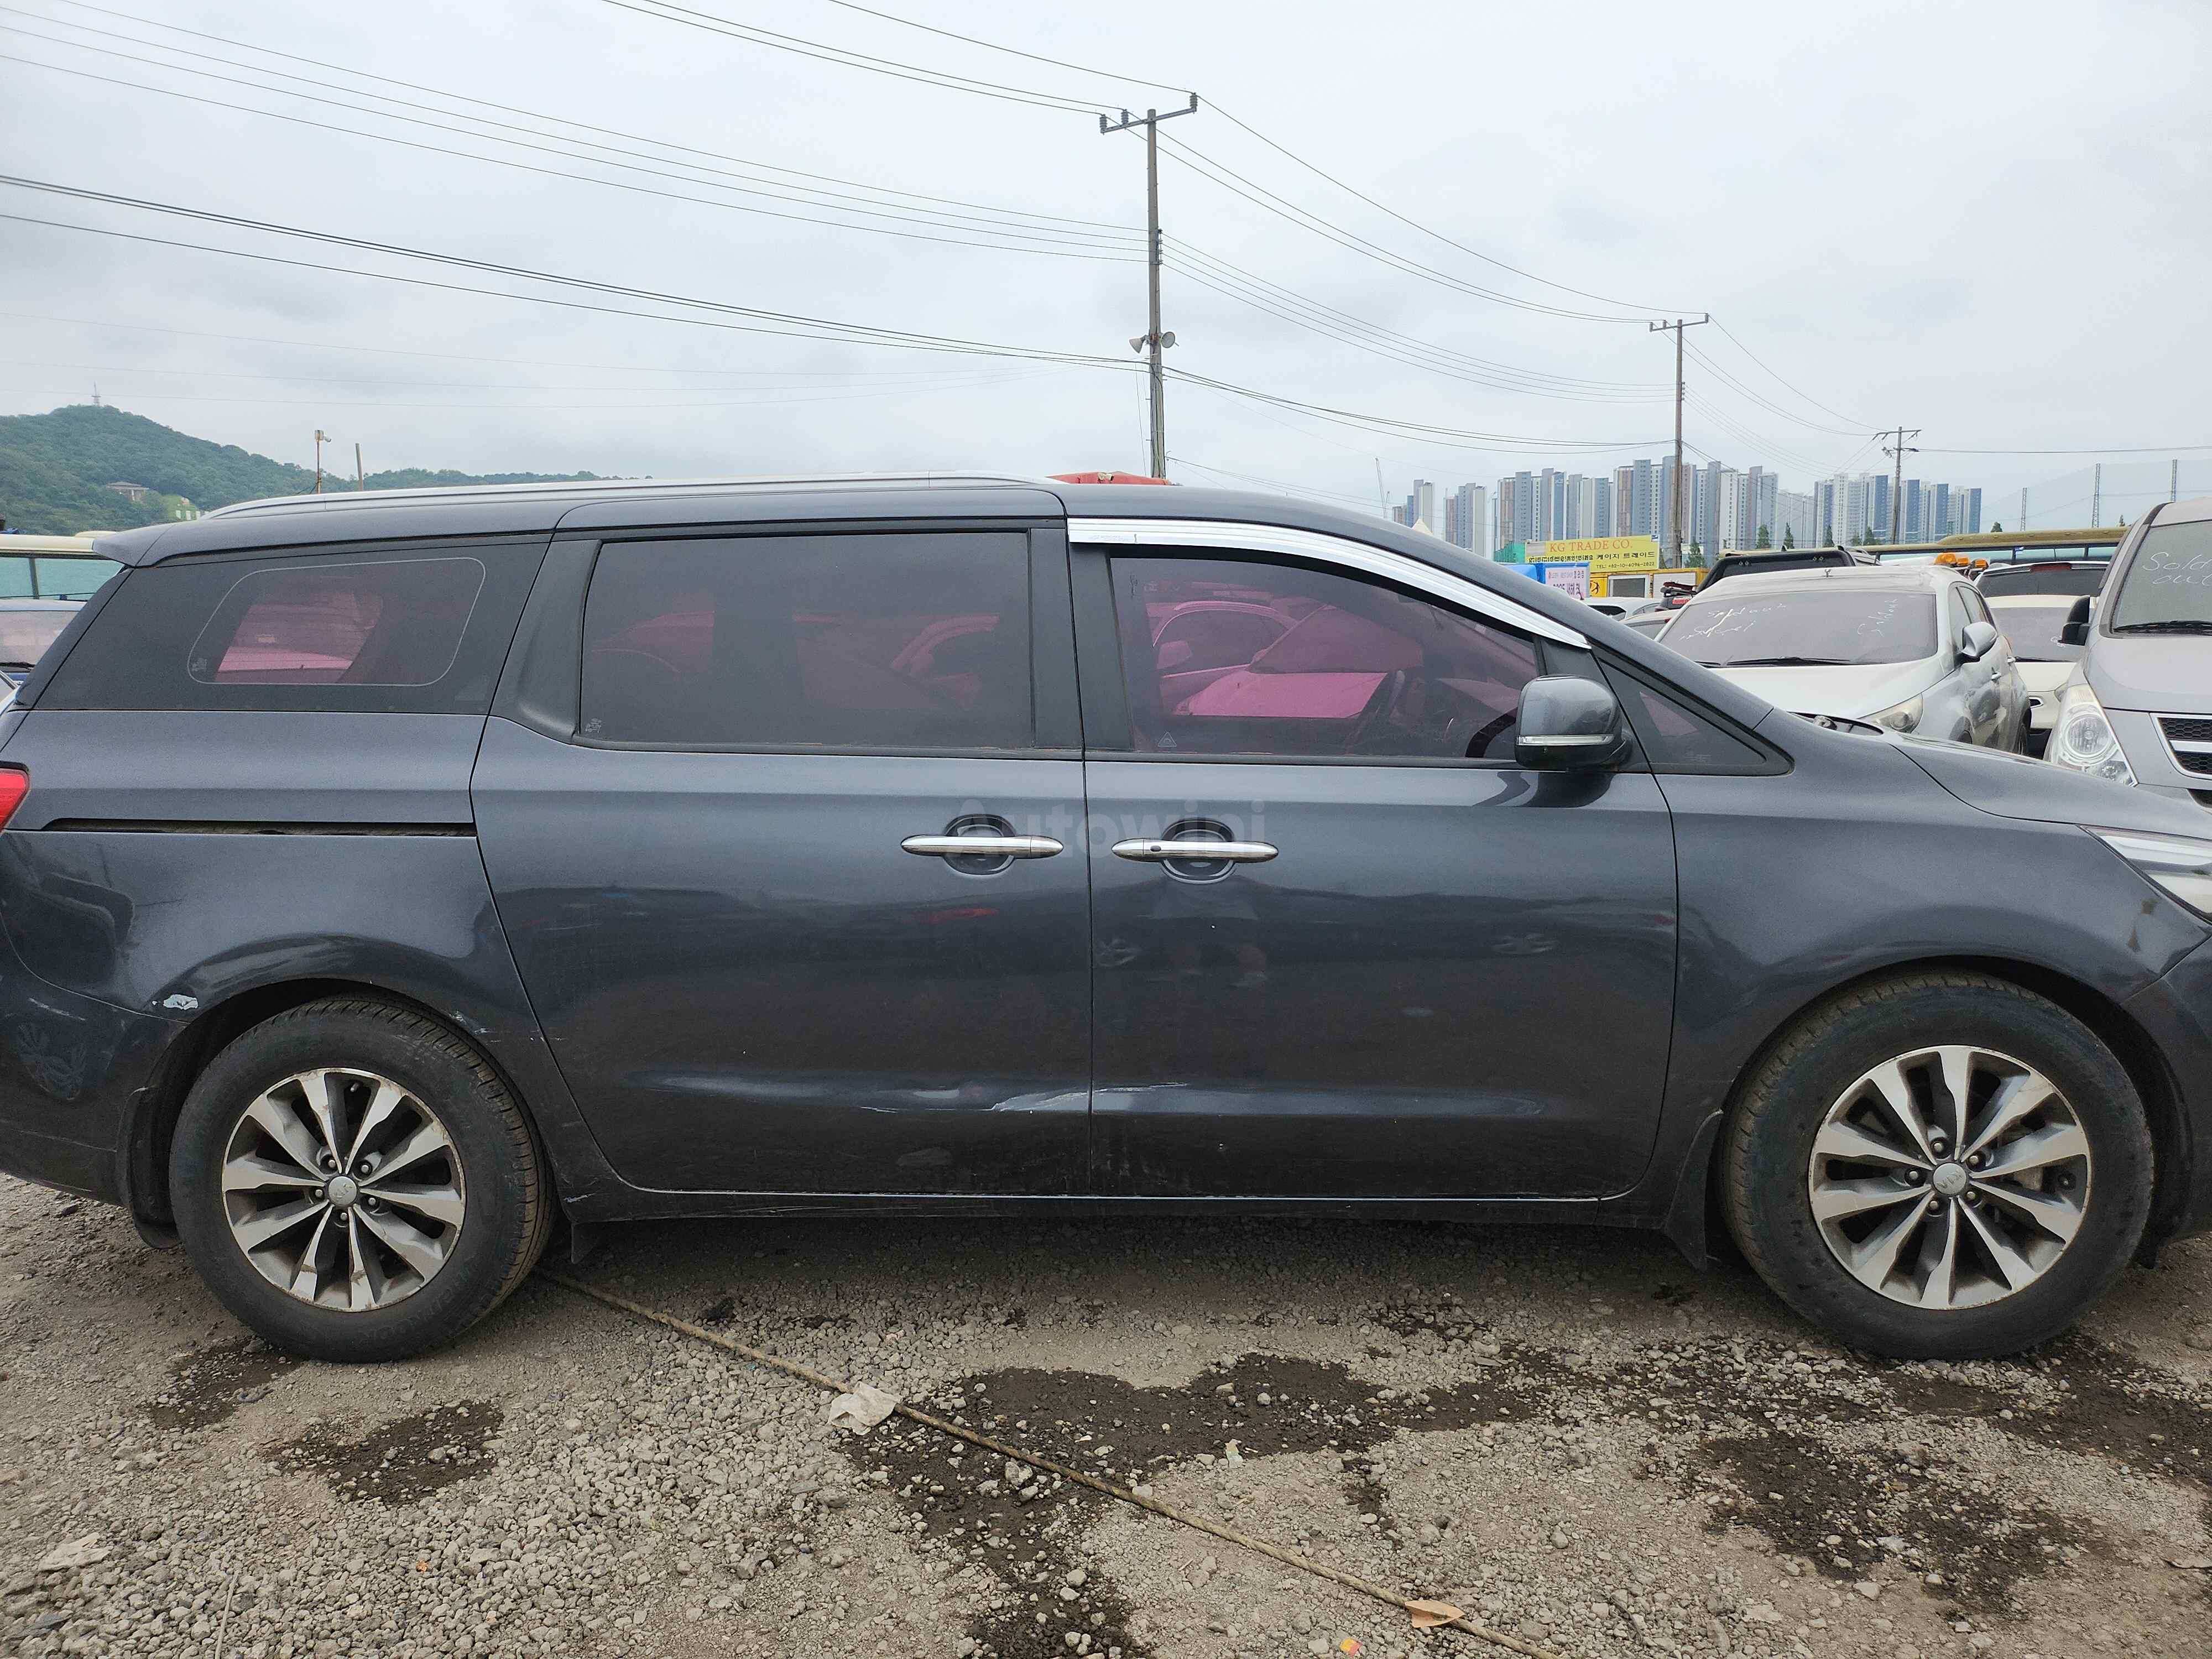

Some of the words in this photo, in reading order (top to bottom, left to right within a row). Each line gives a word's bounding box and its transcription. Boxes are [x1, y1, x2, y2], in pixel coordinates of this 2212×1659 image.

[1550, 542, 1565, 552] KG
[1569, 540, 1609, 551] TRADE
[1612, 539, 1633, 550] CO.
[2142, 552, 2212, 571] Sold
